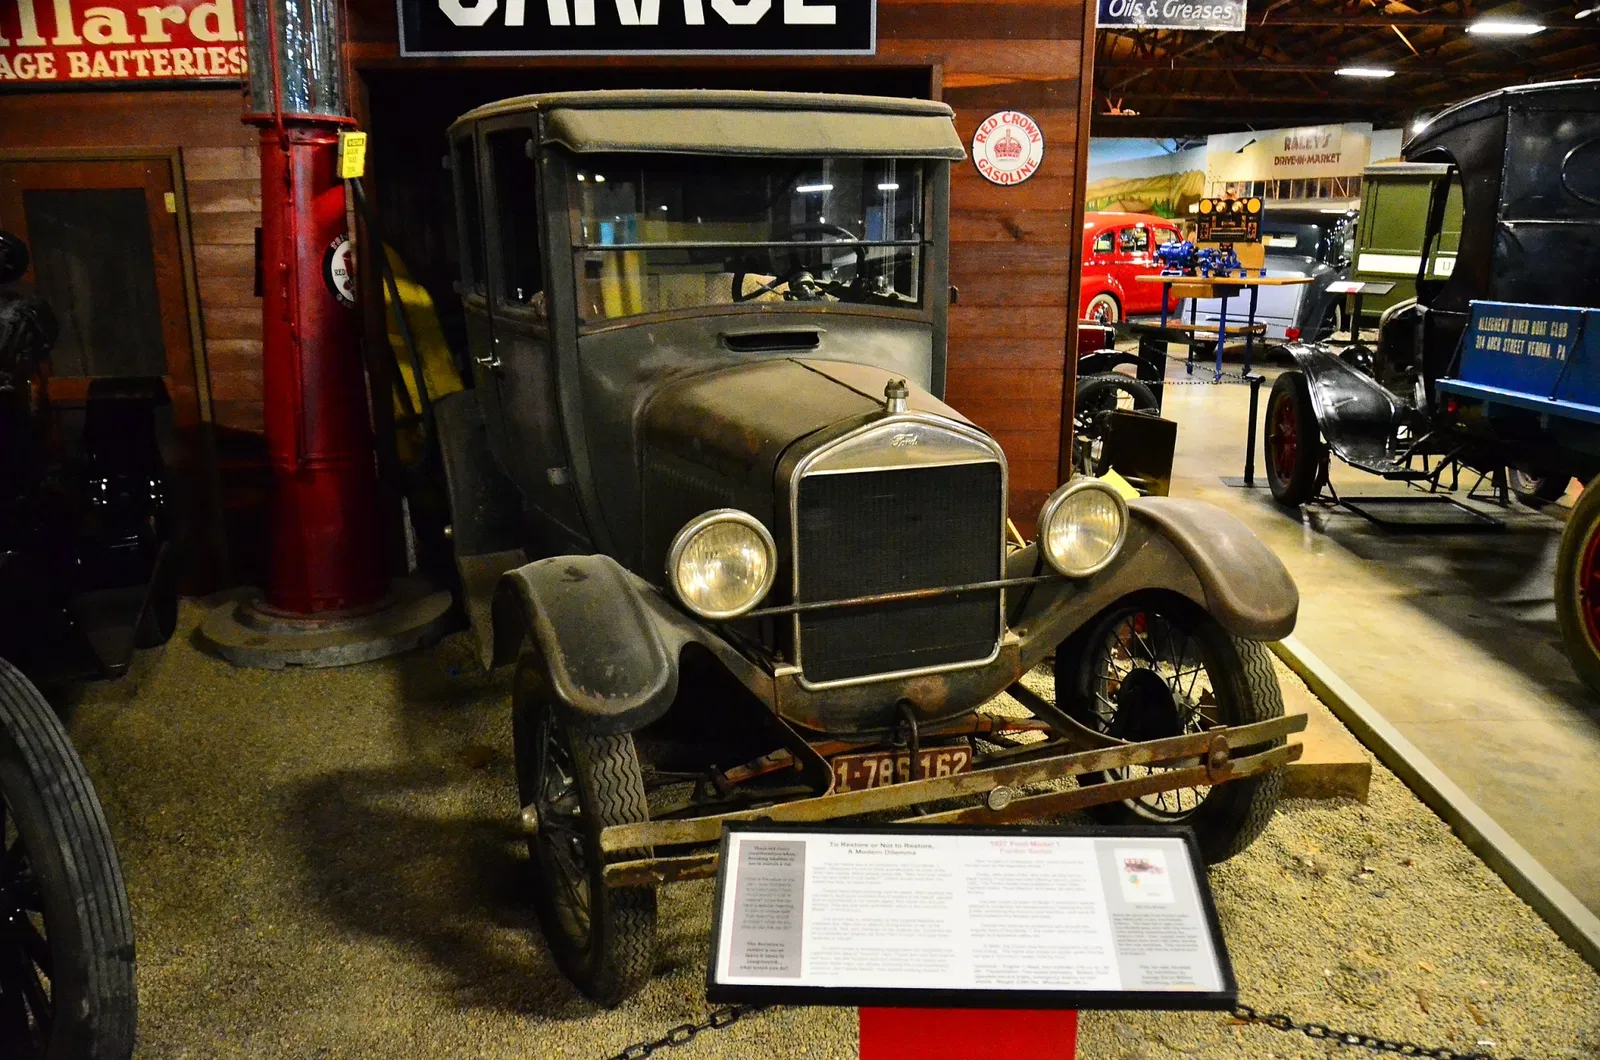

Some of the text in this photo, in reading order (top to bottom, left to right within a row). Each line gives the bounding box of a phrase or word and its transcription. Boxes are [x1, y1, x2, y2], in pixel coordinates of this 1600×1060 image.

[1109, 0, 1232, 19] Oils & Greases
[0, 0, 243, 46] llard
[67, 46, 248, 78] BATTERIES
[976, 112, 1041, 144] RED CROWN
[978, 158, 1038, 183] GASOLINE
[1511, 319, 1529, 335] RIVER
[1550, 321, 1568, 338] CLUB
[1503, 338, 1525, 354] STREET
[892, 433, 918, 447] Ford
